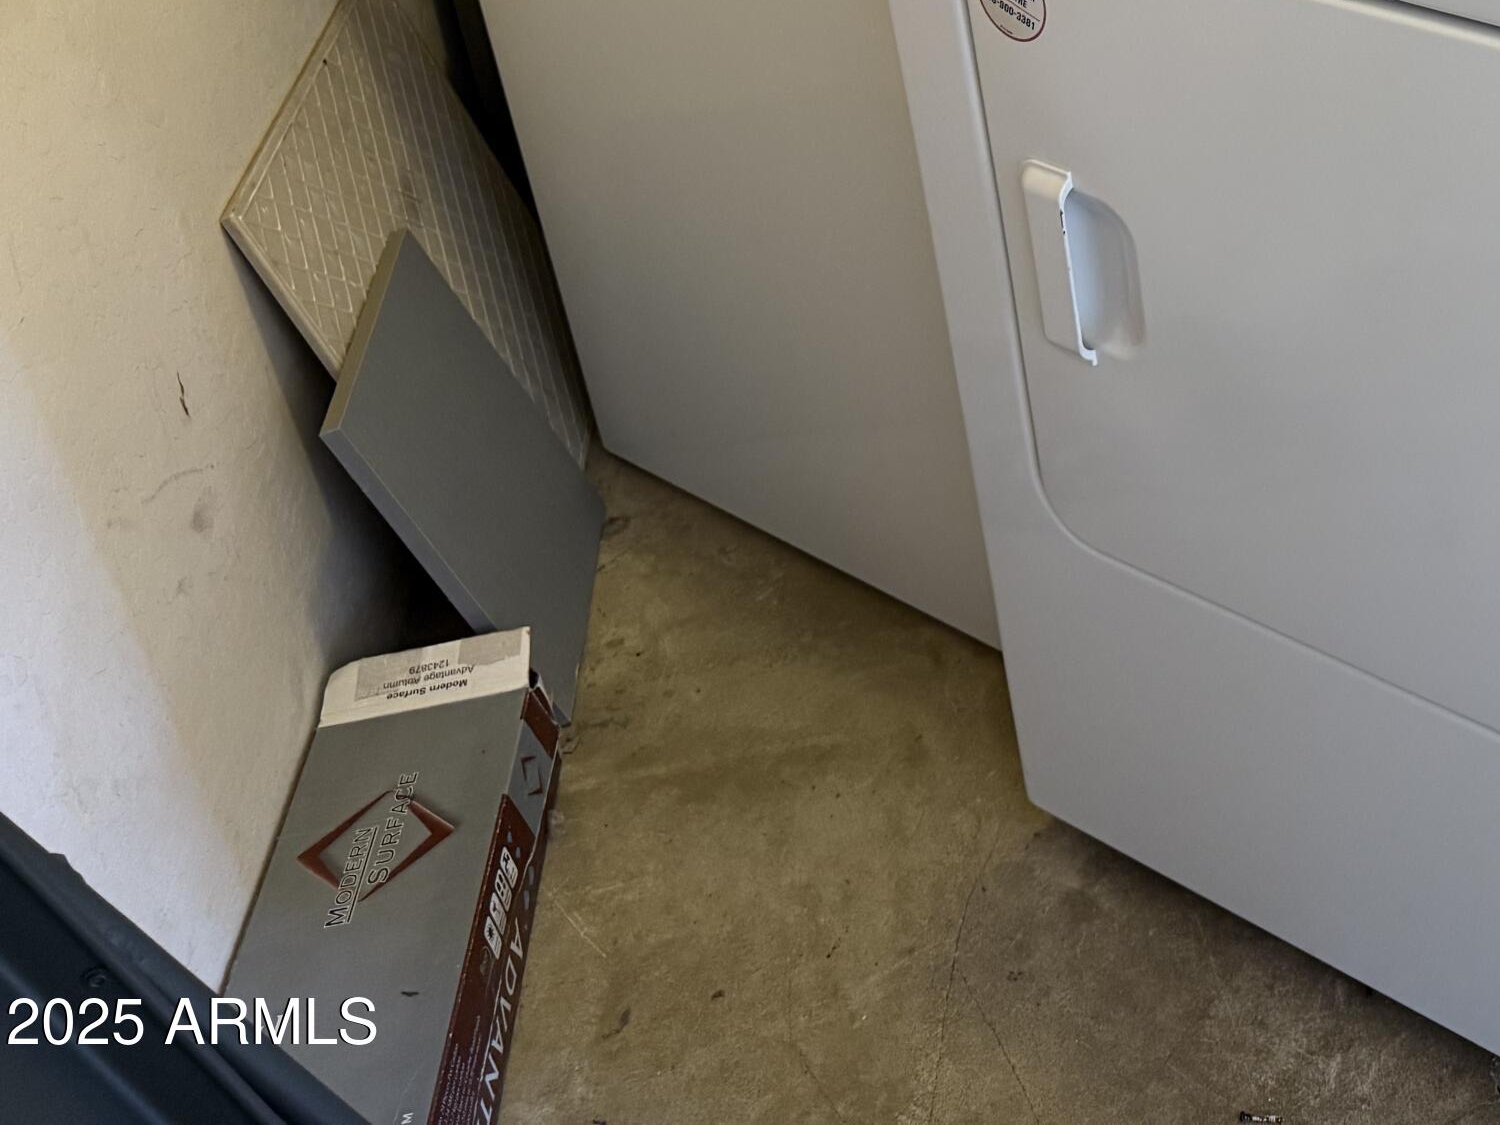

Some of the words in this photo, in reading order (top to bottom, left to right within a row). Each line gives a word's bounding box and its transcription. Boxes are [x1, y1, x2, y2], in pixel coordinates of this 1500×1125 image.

[409, 659, 449, 675] 1243879
[424, 666, 475, 681] Advantage
[386, 686, 425, 700] Surface
[429, 678, 469, 693] Modern
[367, 771, 419, 885] SURFACE
[324, 826, 375, 929] MODERN
[476, 916, 524, 1125] ADVANT
